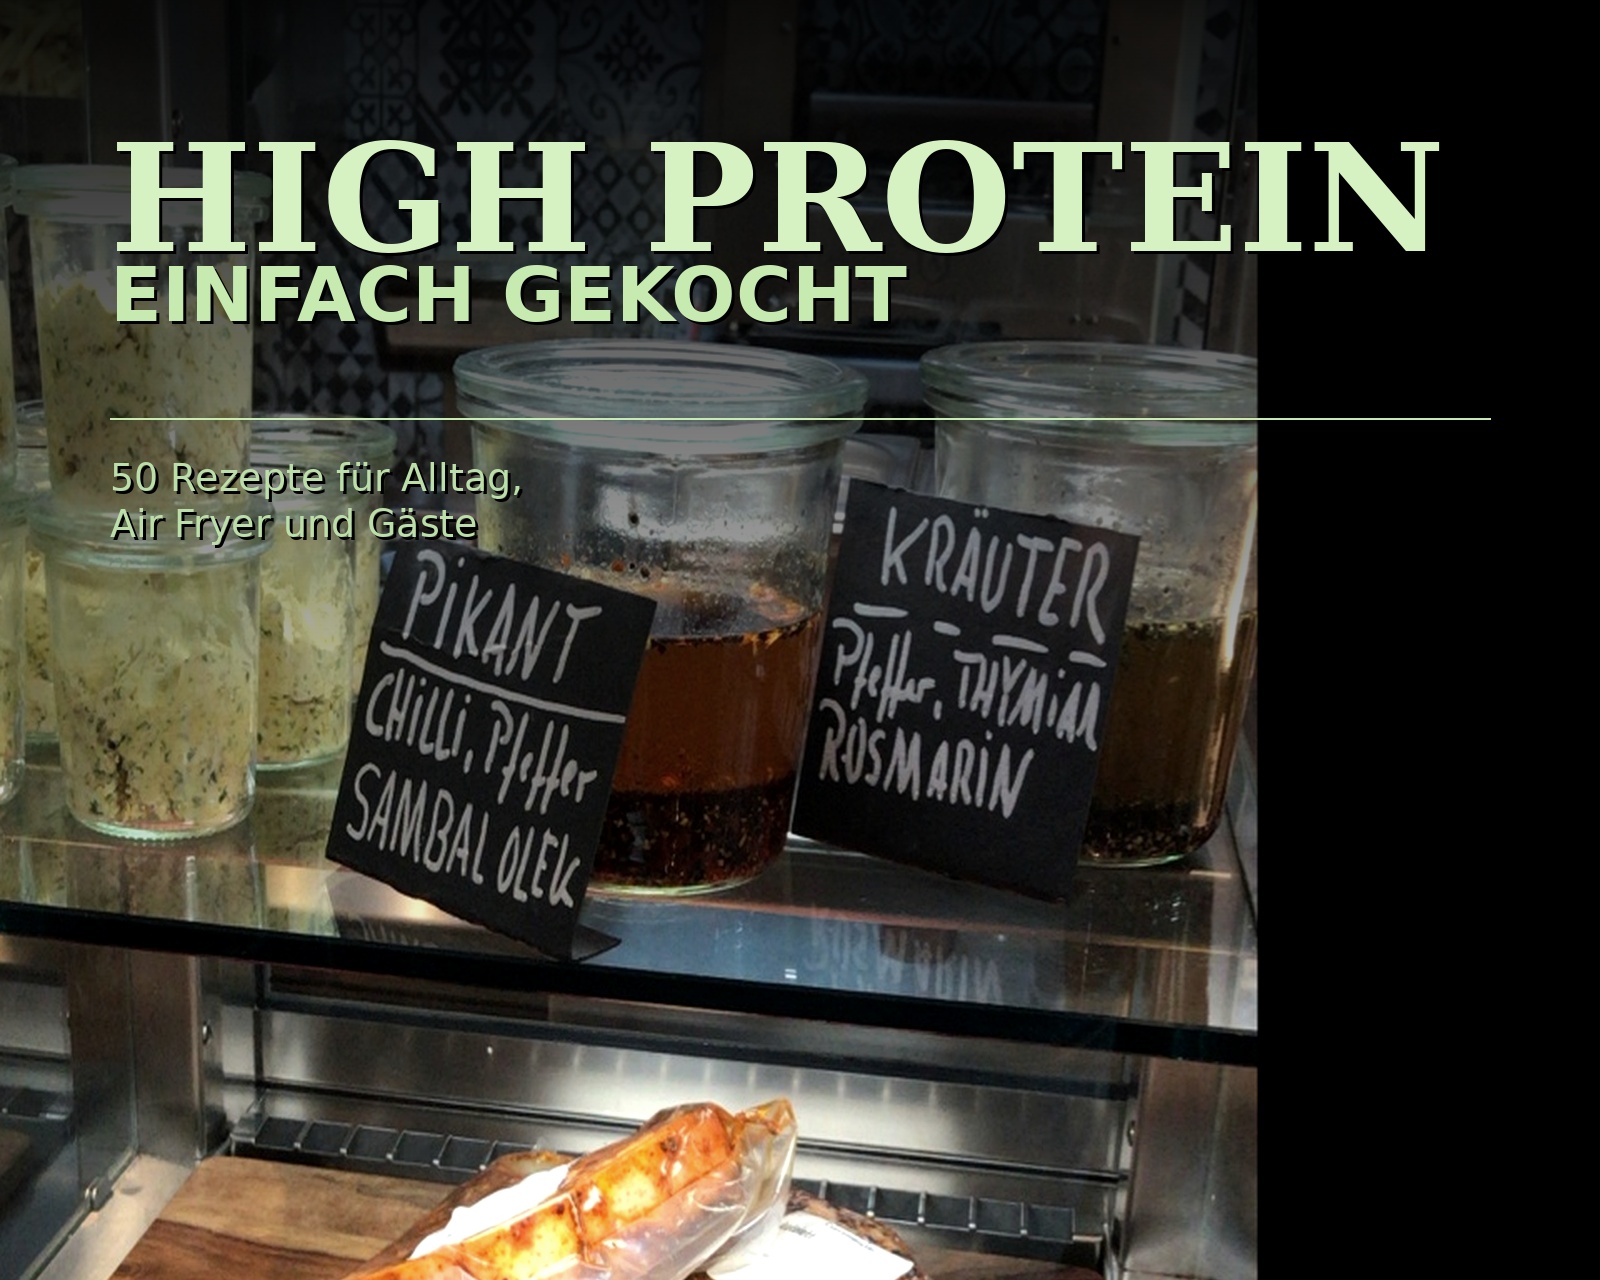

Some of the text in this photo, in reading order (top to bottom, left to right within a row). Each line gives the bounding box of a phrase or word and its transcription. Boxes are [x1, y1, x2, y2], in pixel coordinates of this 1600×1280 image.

[880, 506, 1110, 646] KRÄUTER
[484, 700, 598, 814] Pfeffer
[346, 763, 582, 909] SAMBAL OLEK
